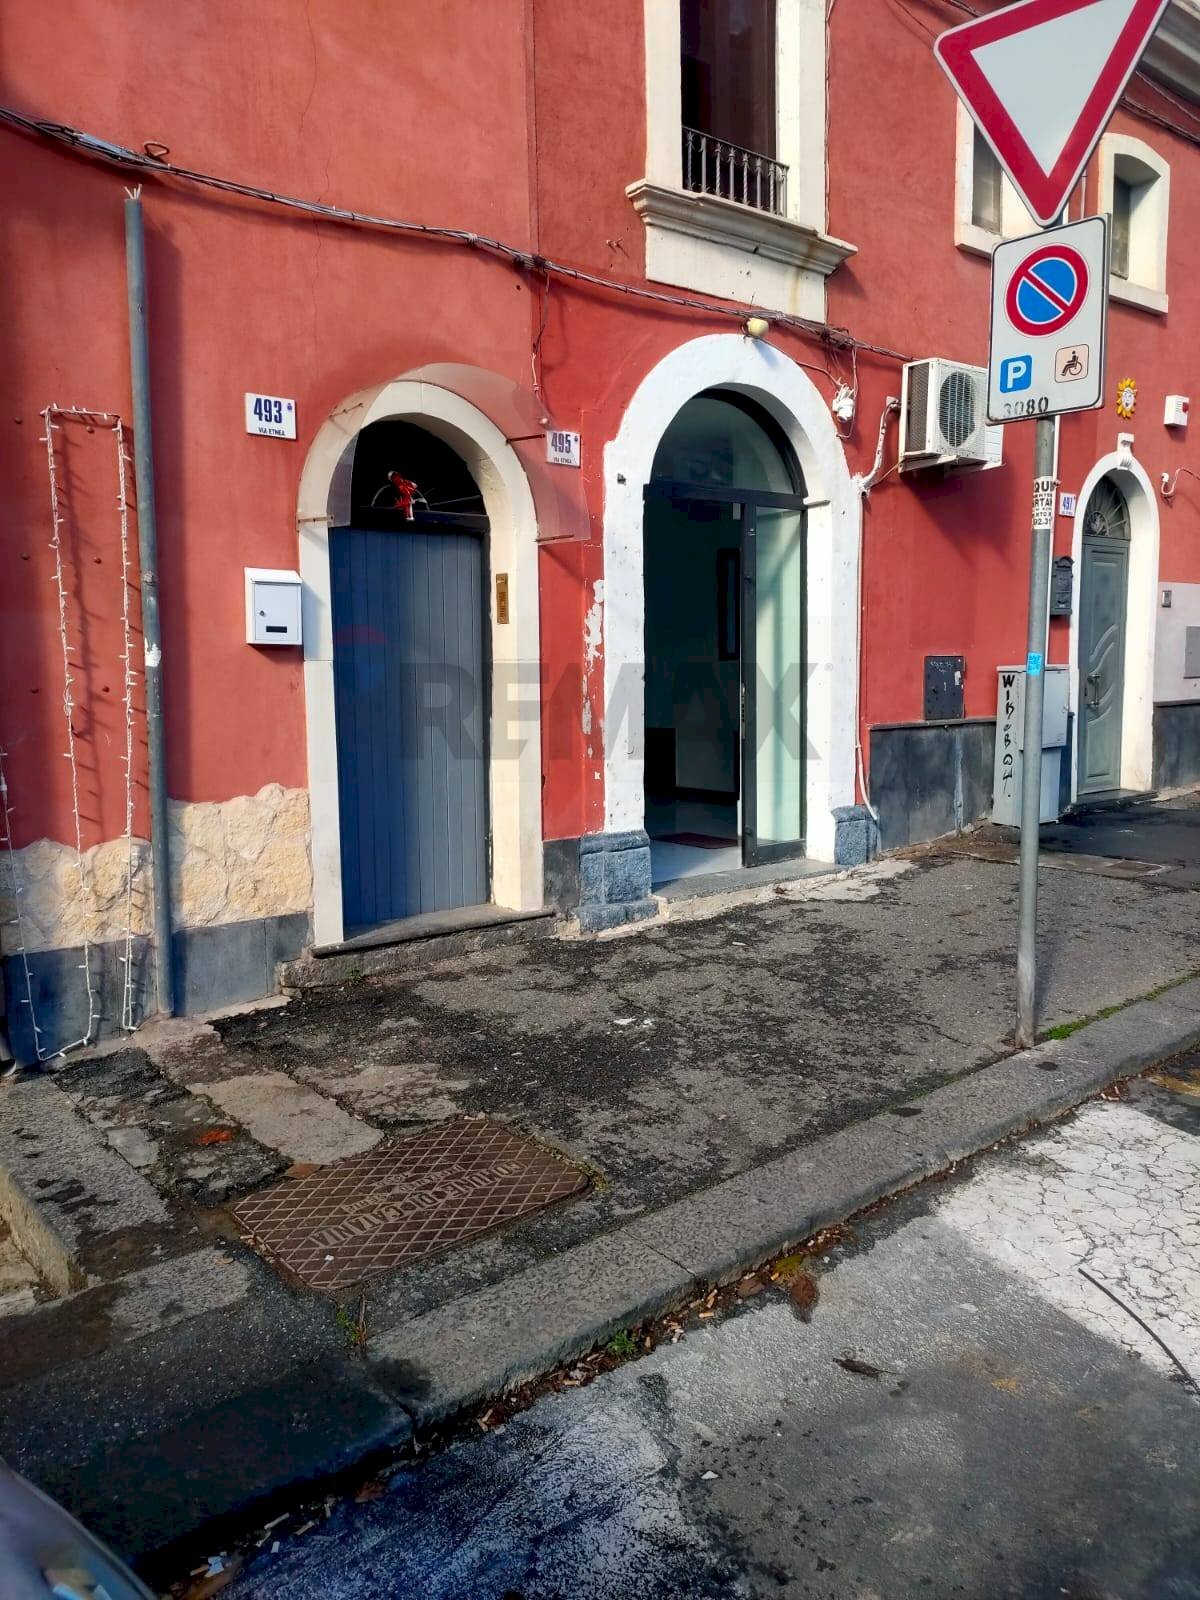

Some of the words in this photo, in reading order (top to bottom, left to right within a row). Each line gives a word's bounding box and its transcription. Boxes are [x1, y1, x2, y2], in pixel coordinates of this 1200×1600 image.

[1007, 361, 1027, 389] P
[253, 397, 283, 424] 493
[551, 432, 572, 454] 495
[406, 1191, 440, 1211] DI
